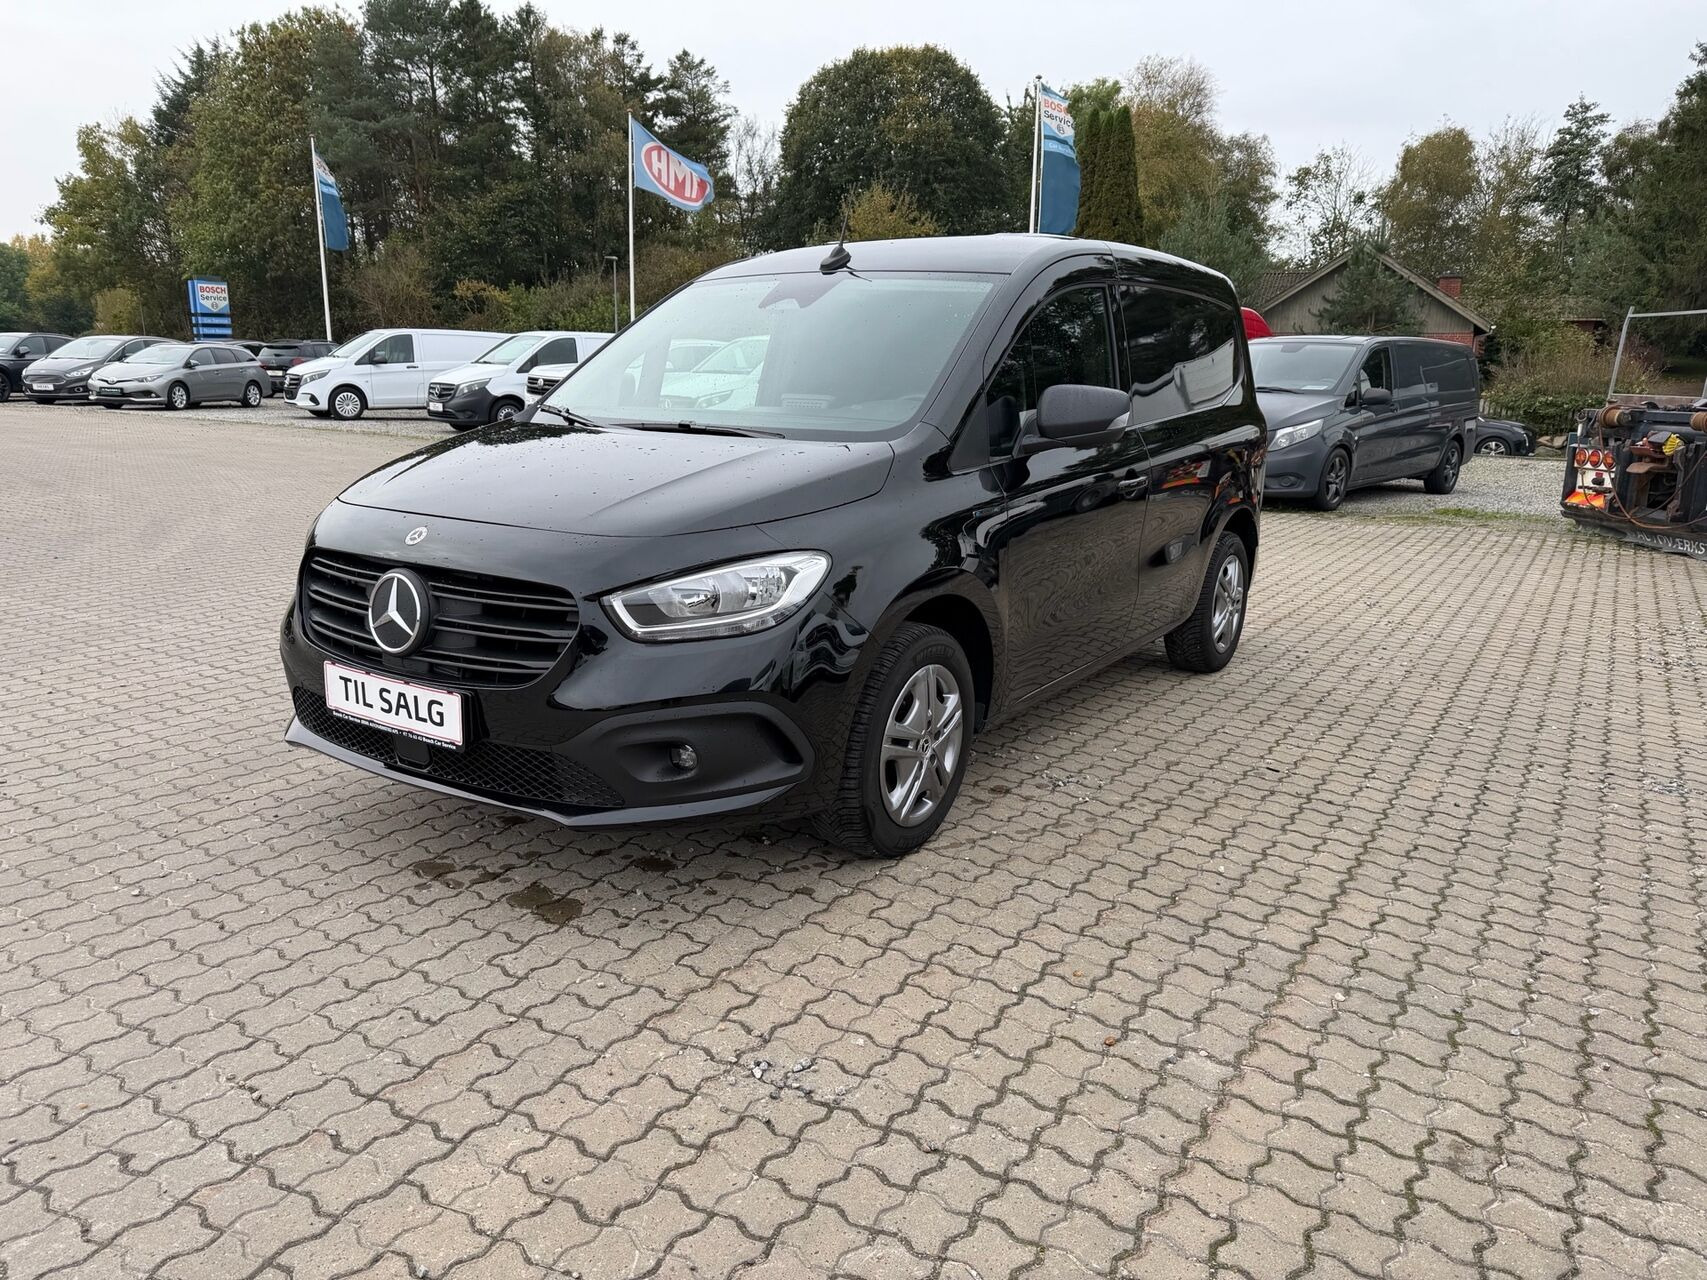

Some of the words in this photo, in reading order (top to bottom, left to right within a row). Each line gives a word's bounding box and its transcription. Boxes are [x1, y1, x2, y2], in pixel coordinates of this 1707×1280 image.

[199, 286, 226, 294] BOSCH
[339, 675, 374, 709] TIL
[379, 686, 444, 727] SALG
